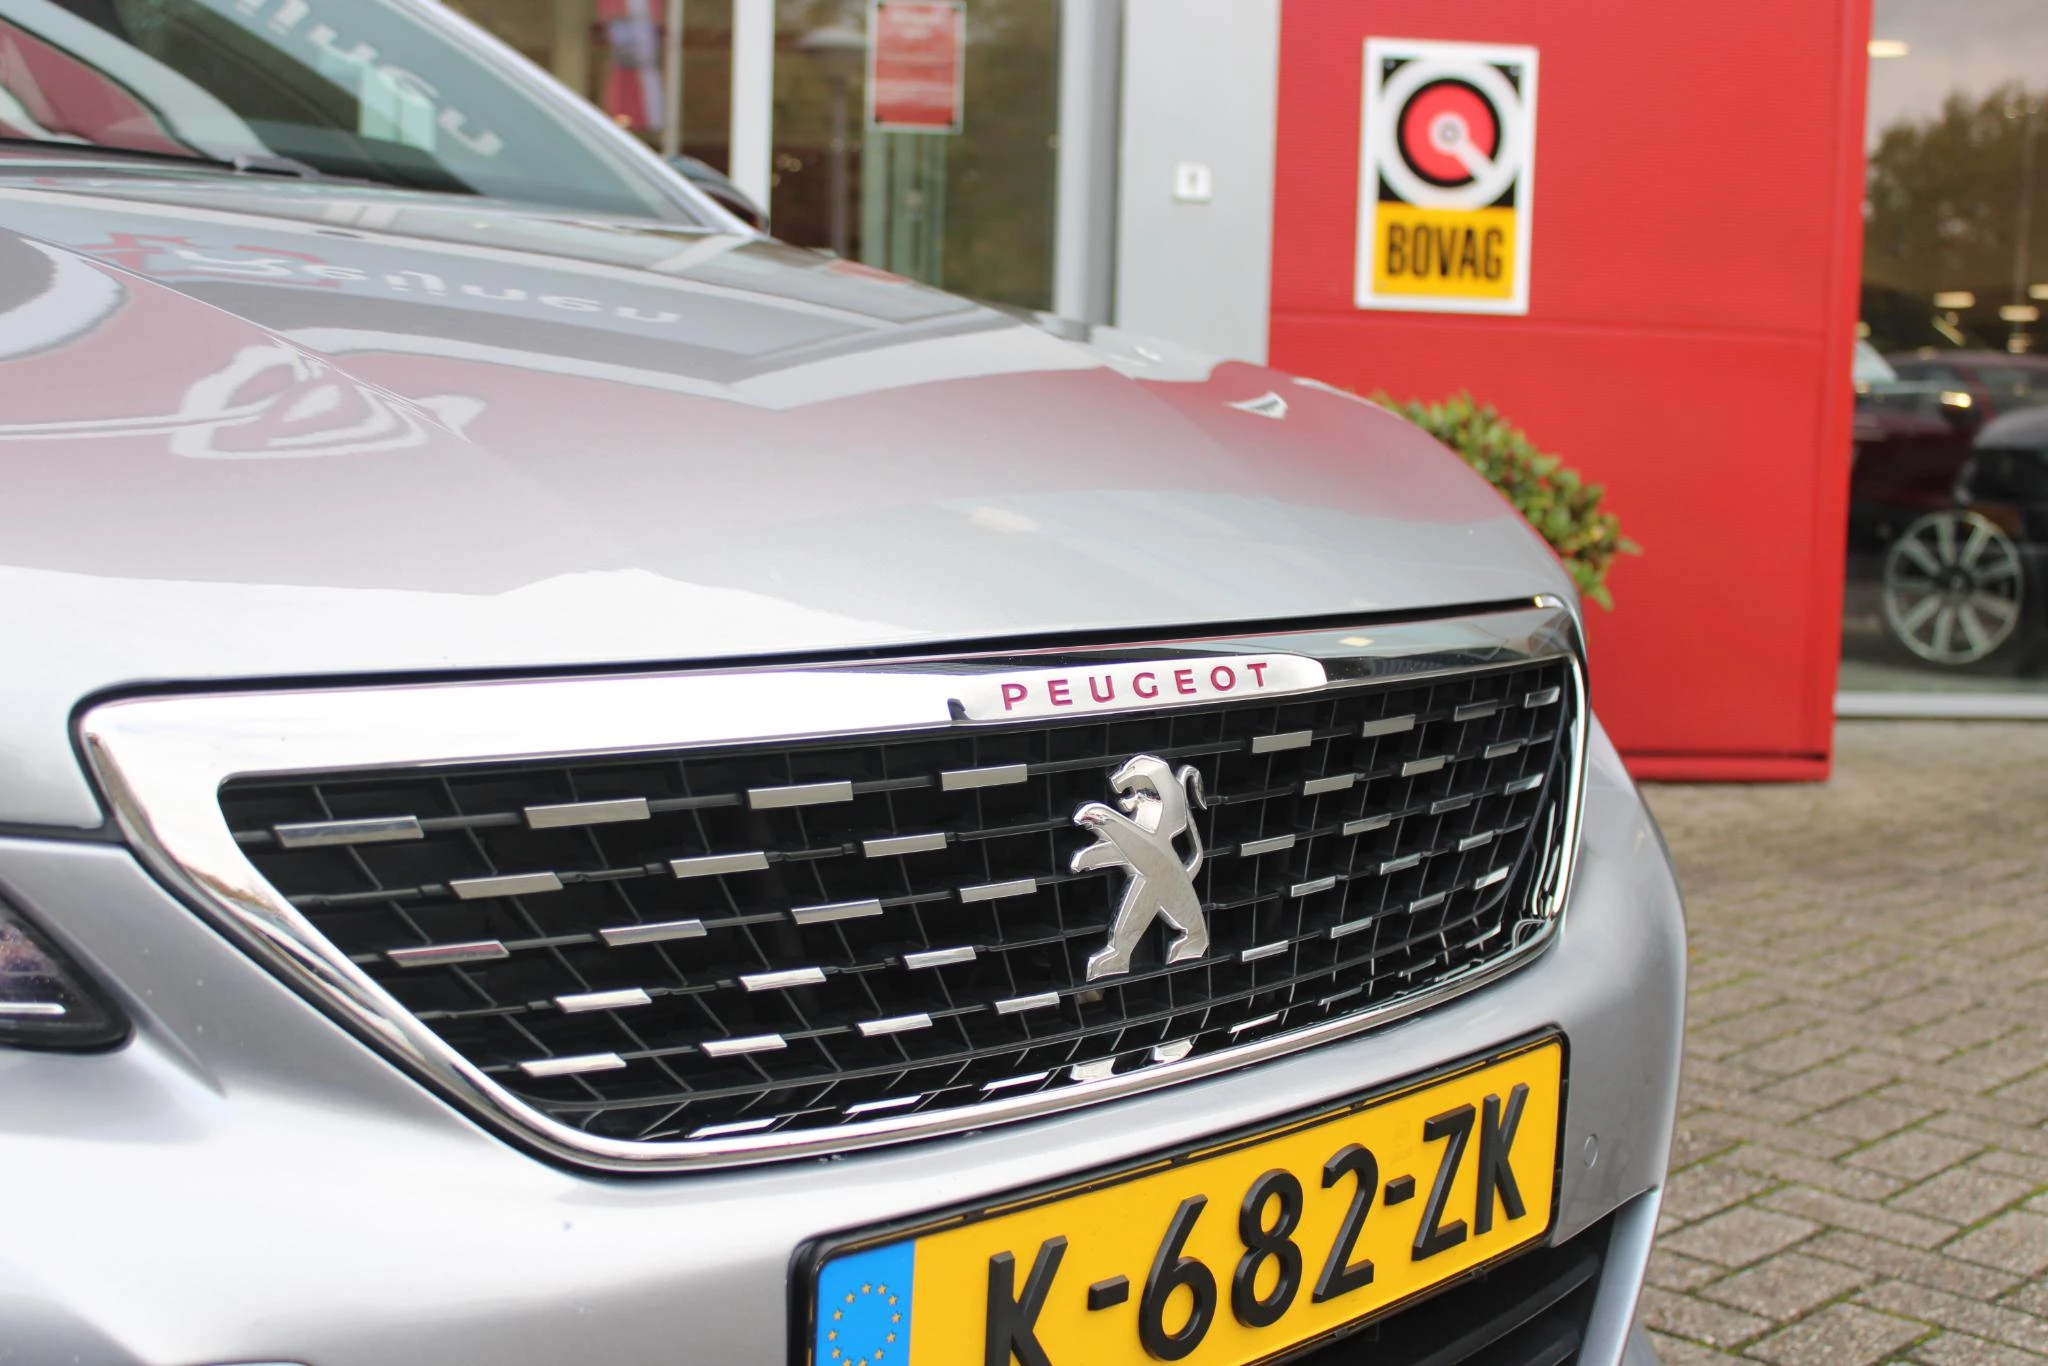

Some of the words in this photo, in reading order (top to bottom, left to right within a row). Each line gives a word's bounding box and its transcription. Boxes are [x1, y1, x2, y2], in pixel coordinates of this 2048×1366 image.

[1387, 222, 1504, 282] BOVAG
[1001, 662, 1270, 711] PEUGEOT
[985, 1083, 1530, 1366] K-682-ZK
